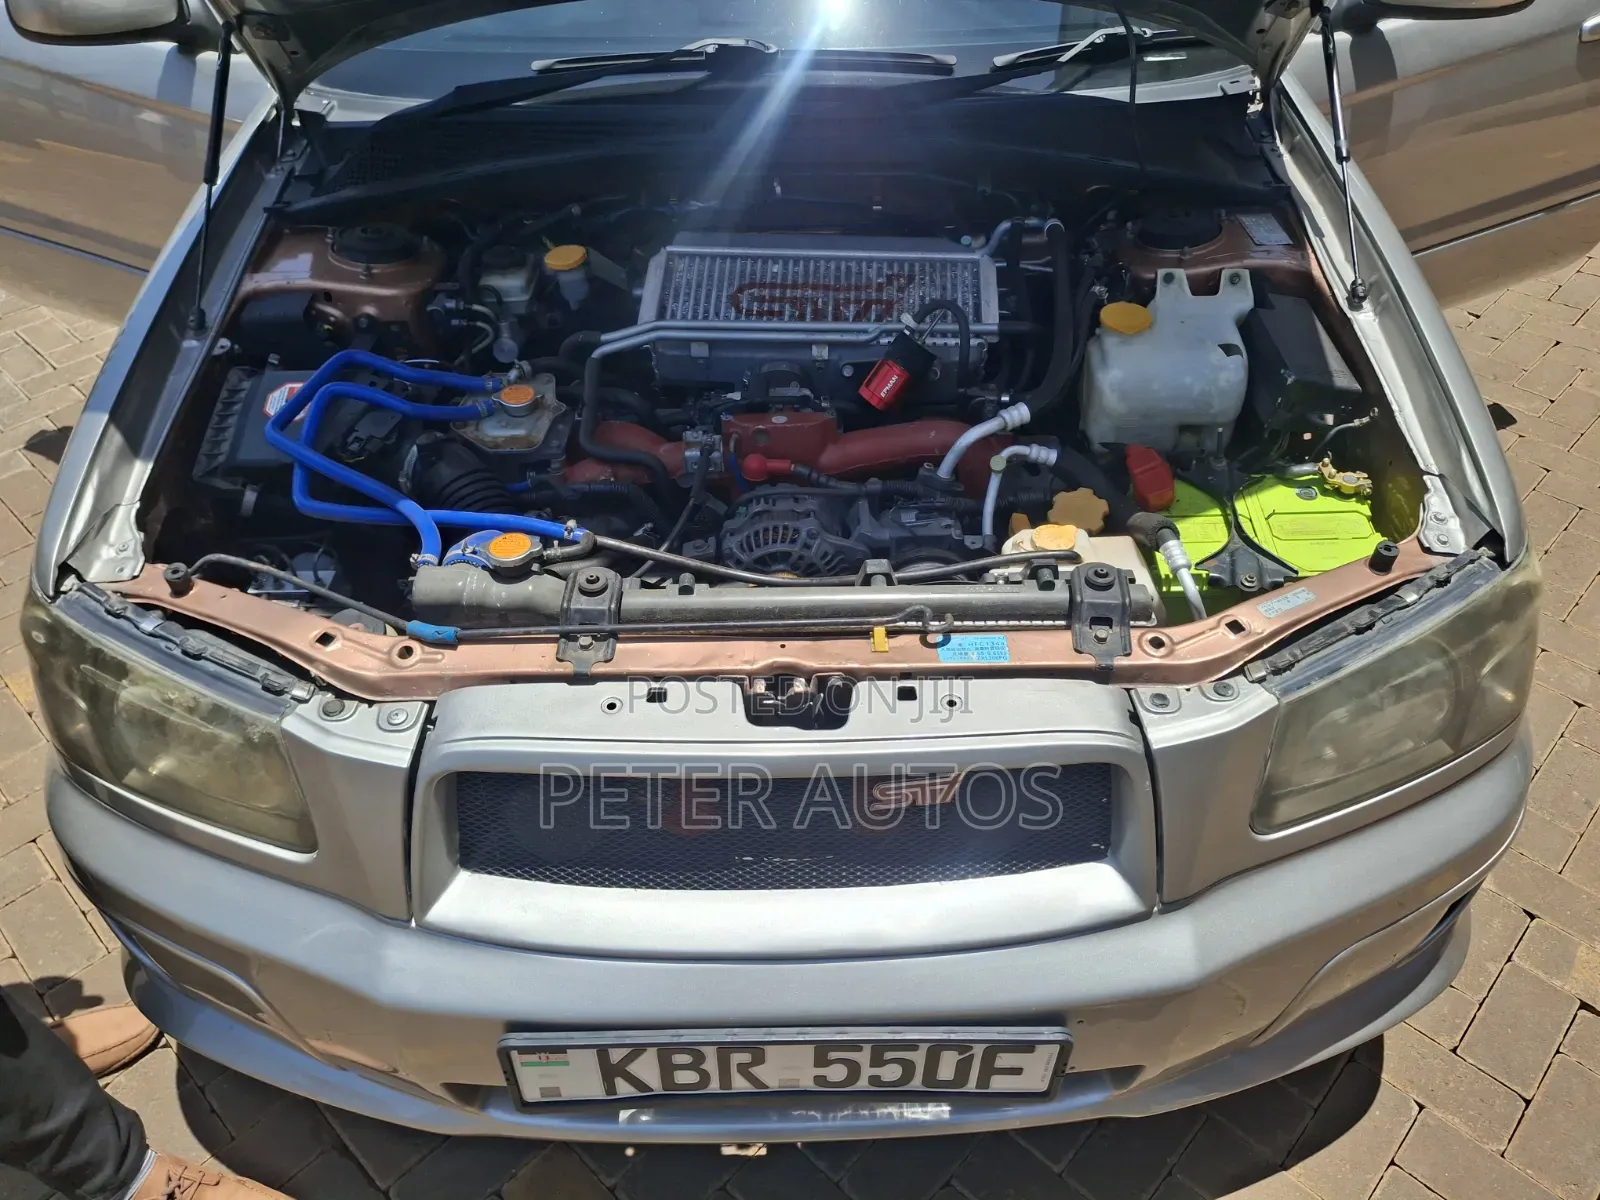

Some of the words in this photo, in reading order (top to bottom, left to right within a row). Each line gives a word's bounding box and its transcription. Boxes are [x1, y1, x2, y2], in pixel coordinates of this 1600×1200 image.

[880, 374, 899, 398] EPMAN
[596, 1047, 770, 1096] KBR
[812, 1043, 1037, 1090] 550F
